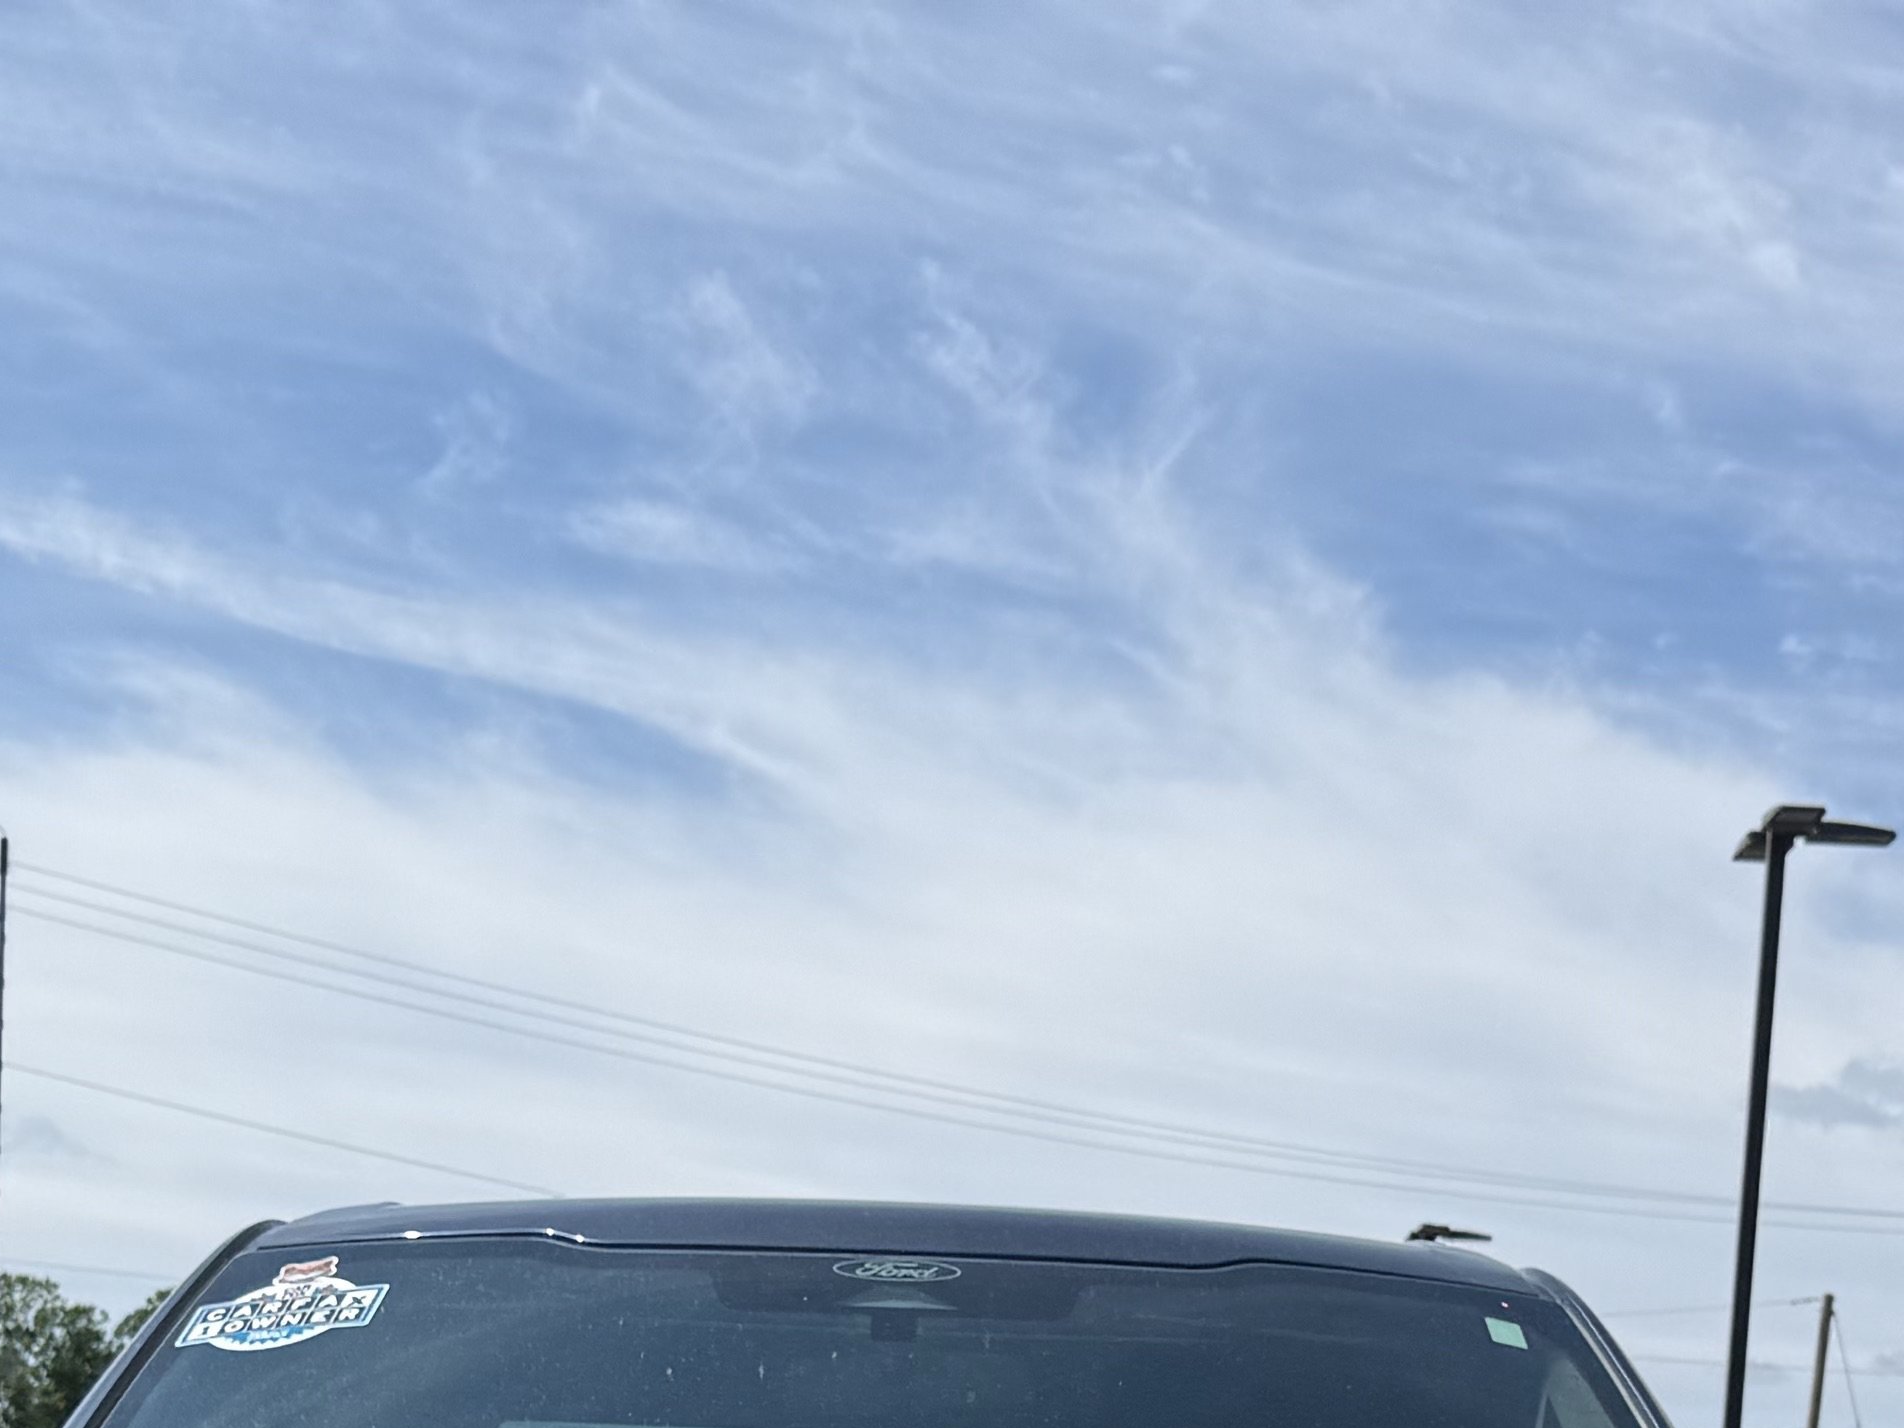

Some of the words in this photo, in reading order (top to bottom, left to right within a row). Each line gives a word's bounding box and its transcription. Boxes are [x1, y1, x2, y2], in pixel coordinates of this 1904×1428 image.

[855, 1262, 939, 1278] Ford
[205, 1293, 368, 1323] CARFAX
[223, 1307, 360, 1333] OWNER
